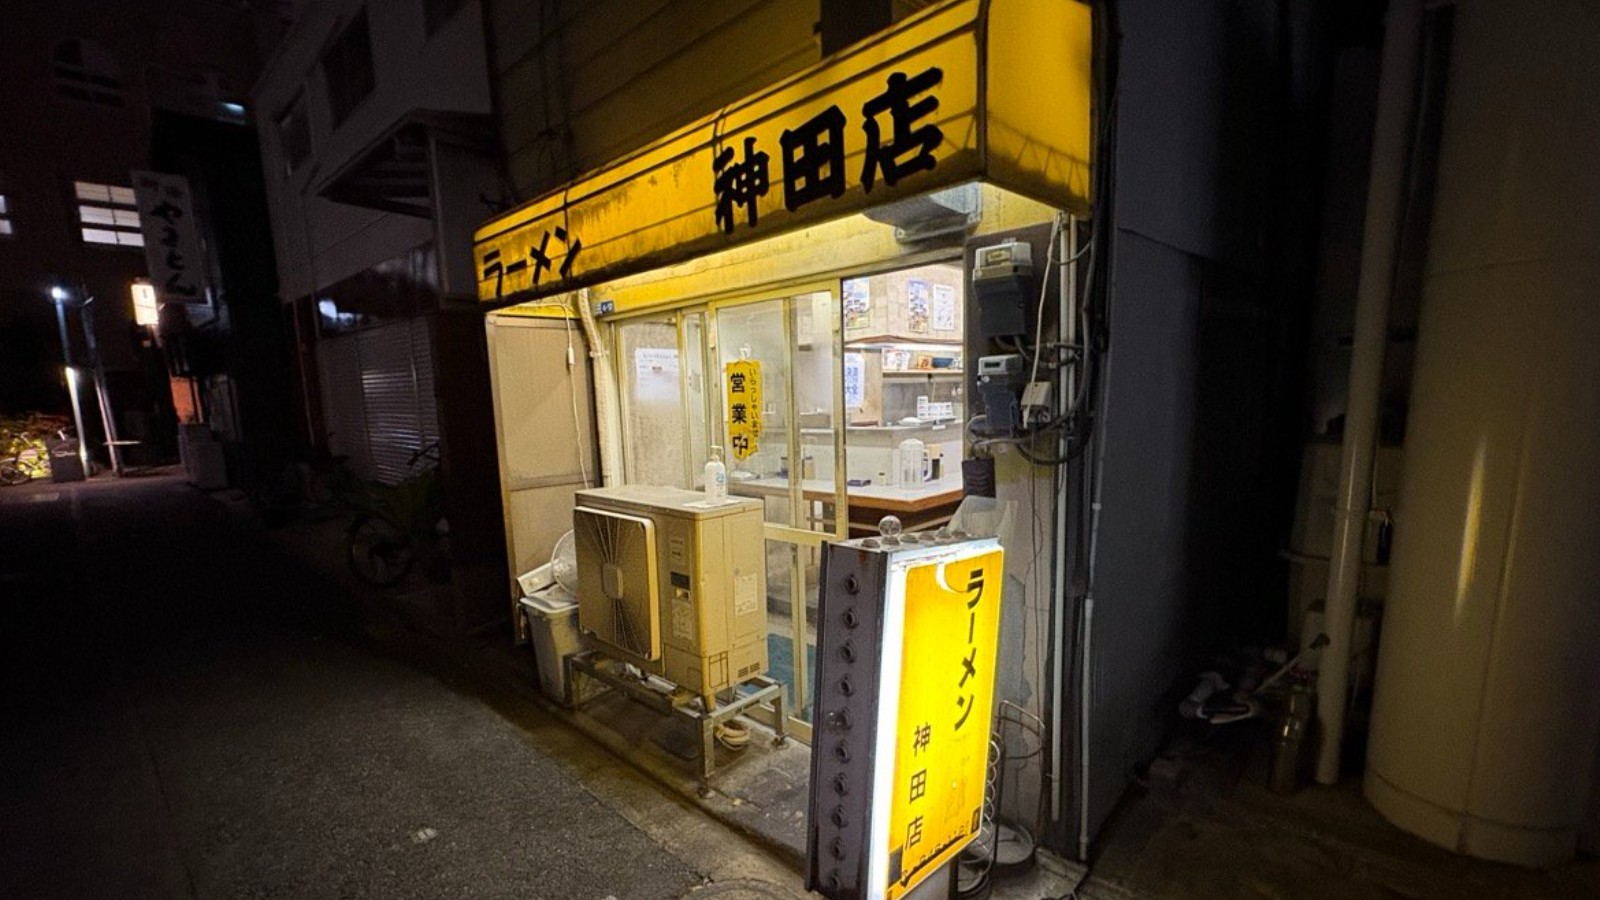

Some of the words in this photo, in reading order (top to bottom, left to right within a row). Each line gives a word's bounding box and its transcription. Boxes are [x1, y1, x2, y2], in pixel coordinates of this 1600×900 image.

[484, 226, 582, 296] ラーメン
[713, 67, 944, 234] 神田店
[730, 372, 748, 455] 営業中
[954, 569, 984, 731] ラーメン
[904, 722, 931, 850] 神田店
